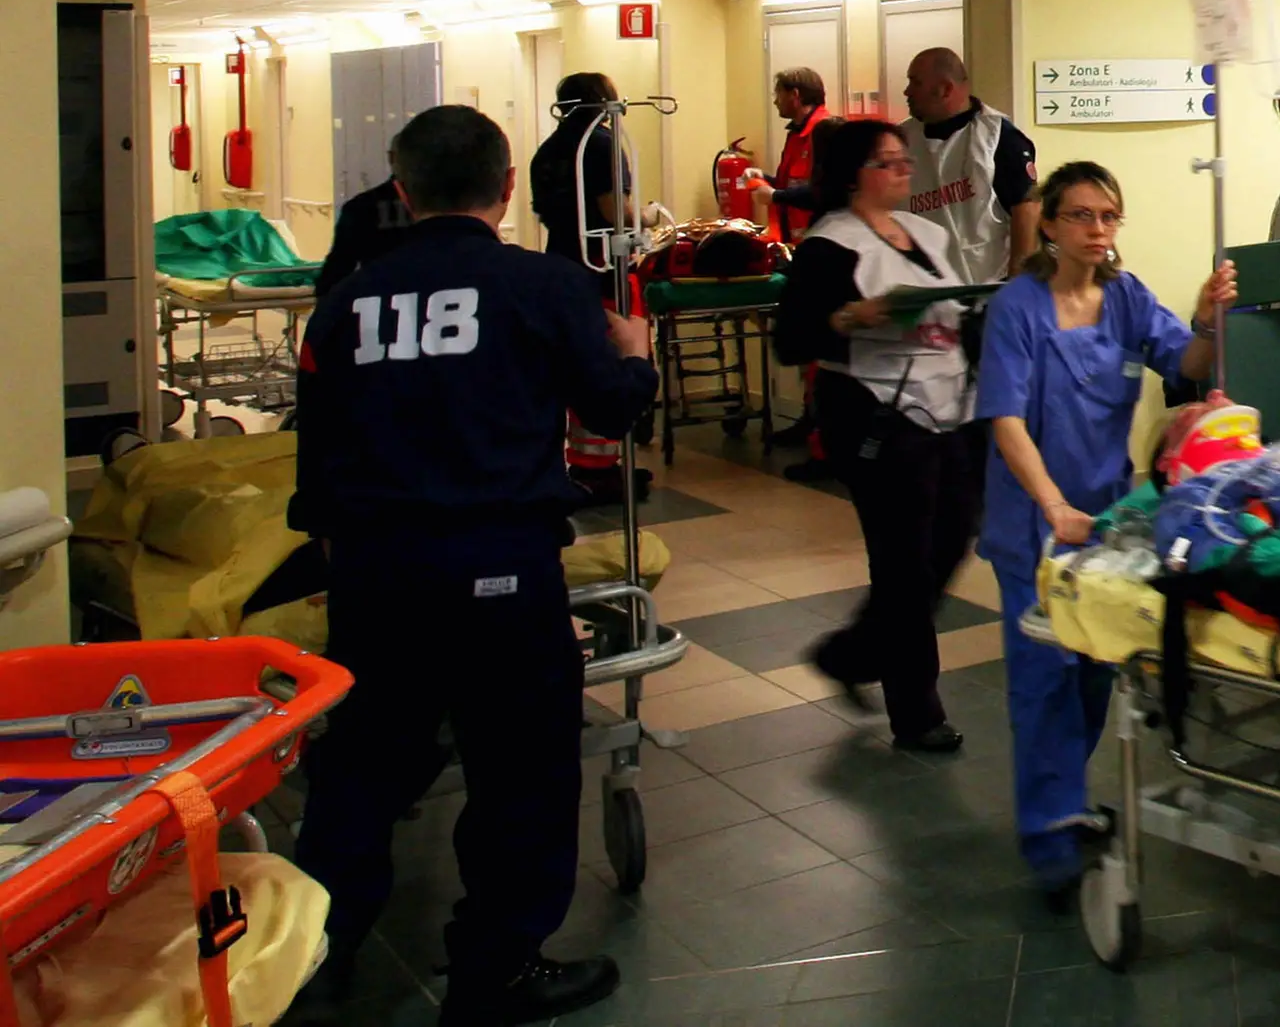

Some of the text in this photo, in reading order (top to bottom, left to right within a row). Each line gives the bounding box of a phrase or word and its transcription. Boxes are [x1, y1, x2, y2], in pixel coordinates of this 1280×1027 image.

[1069, 64, 1111, 76] Zona E
[1070, 95, 1111, 107] Zona F
[352, 287, 479, 365] 118
